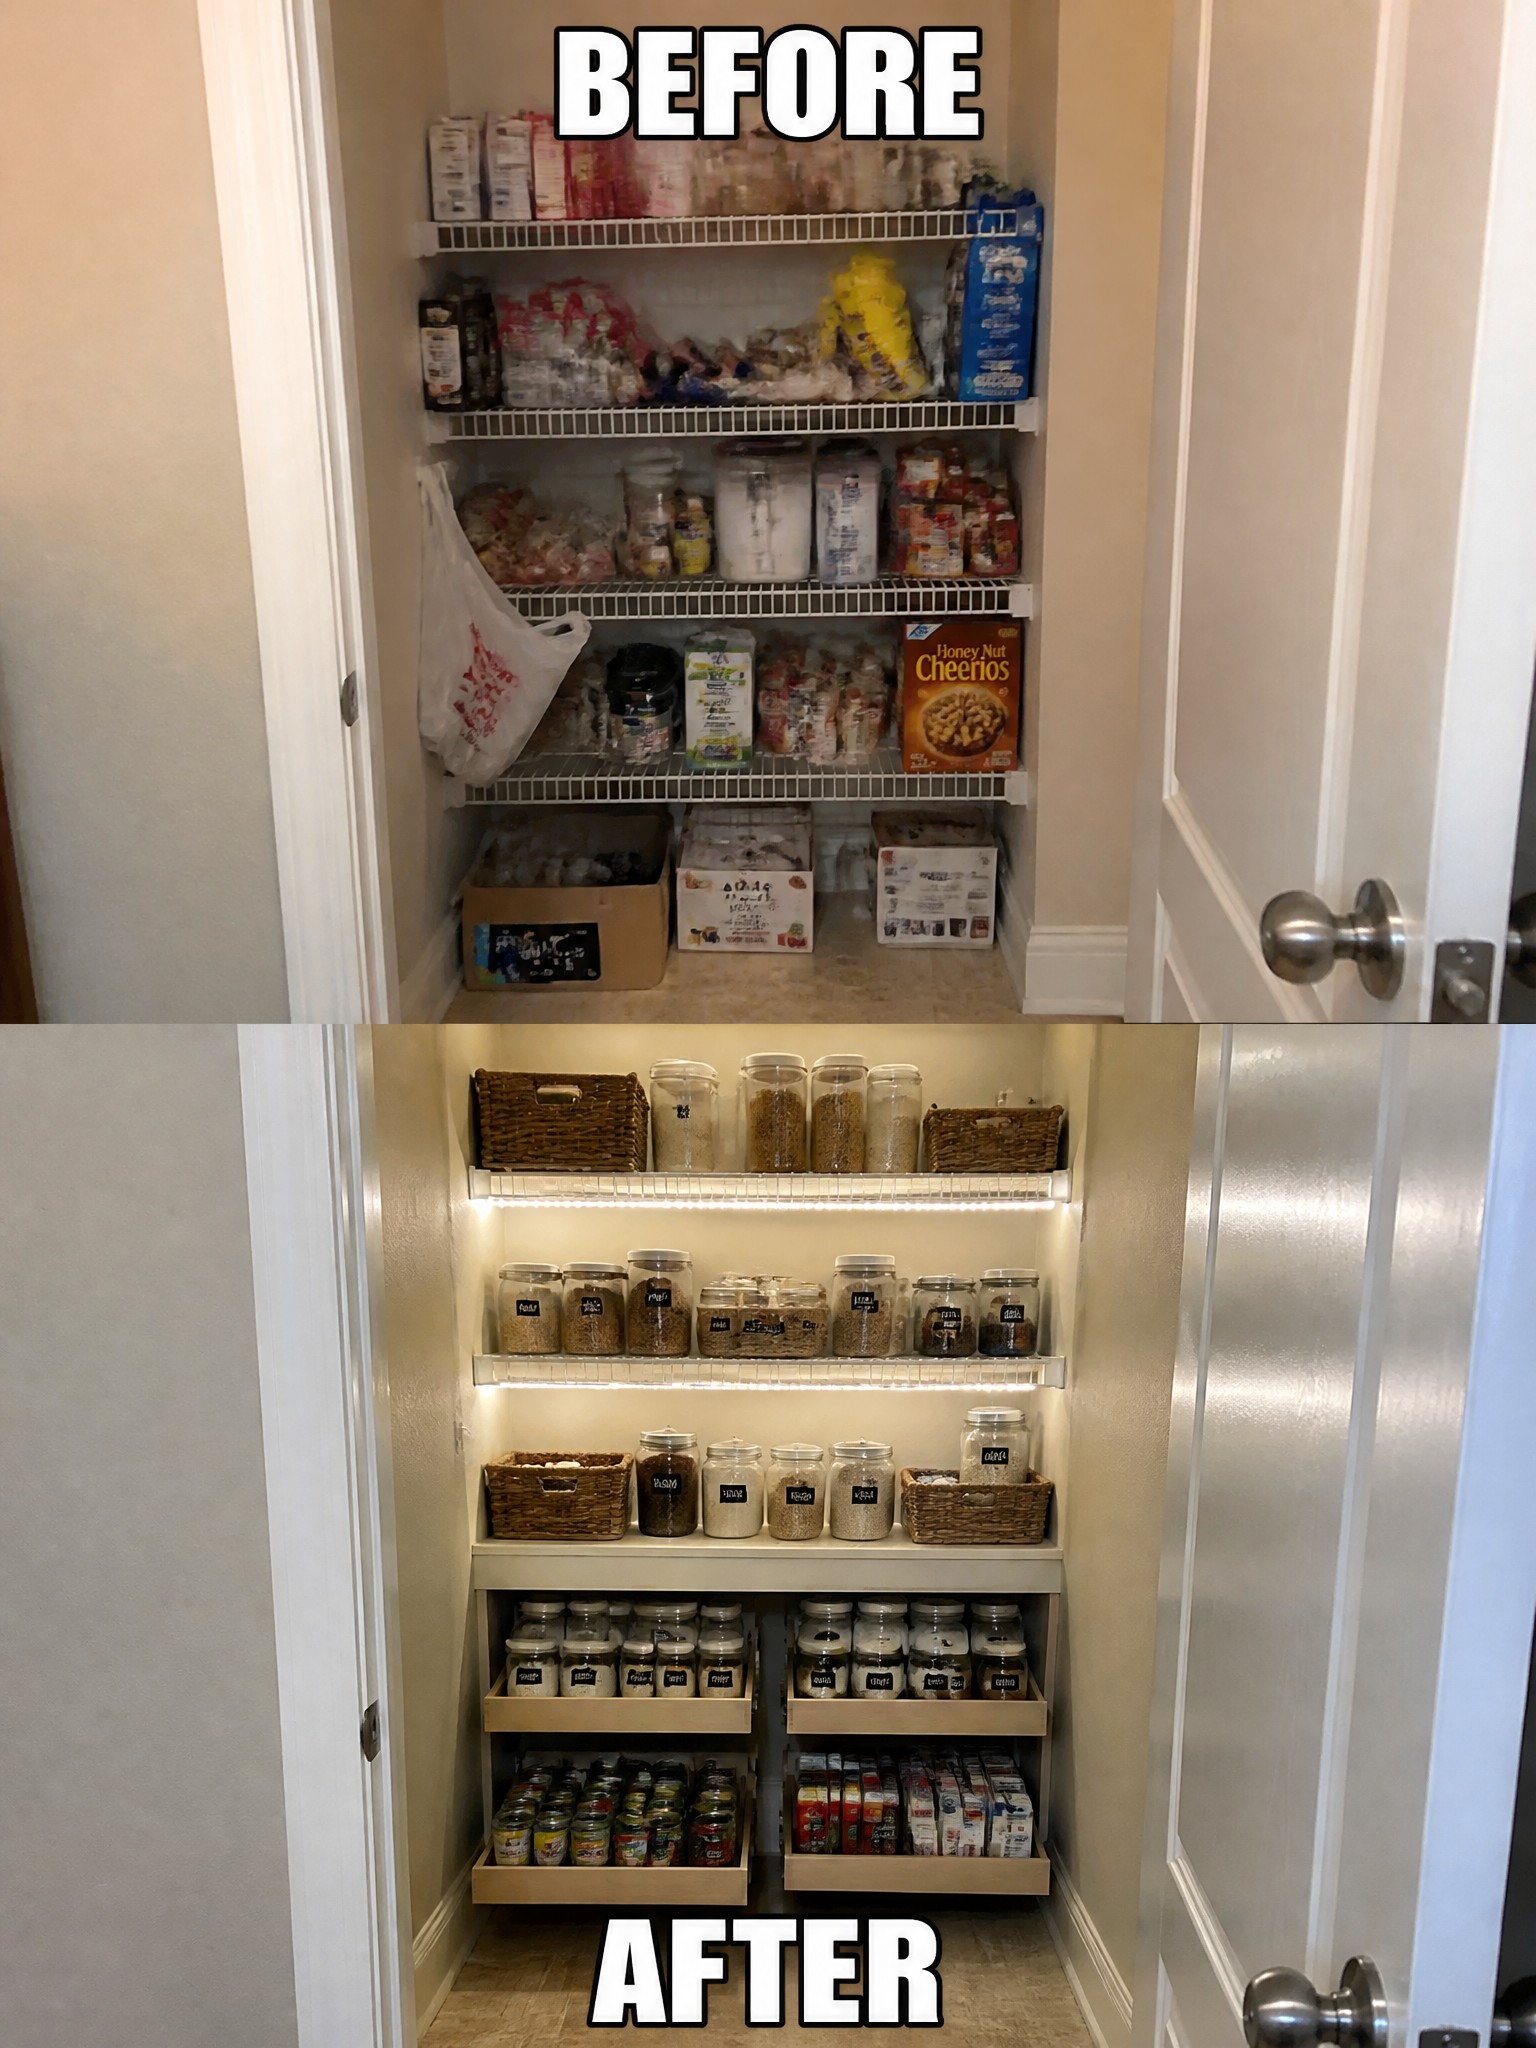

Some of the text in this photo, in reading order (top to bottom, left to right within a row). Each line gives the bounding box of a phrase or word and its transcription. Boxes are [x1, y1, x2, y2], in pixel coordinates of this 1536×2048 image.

[937, 644, 1006, 659] Honey Nut
[916, 655, 1010, 681] Cheerios
